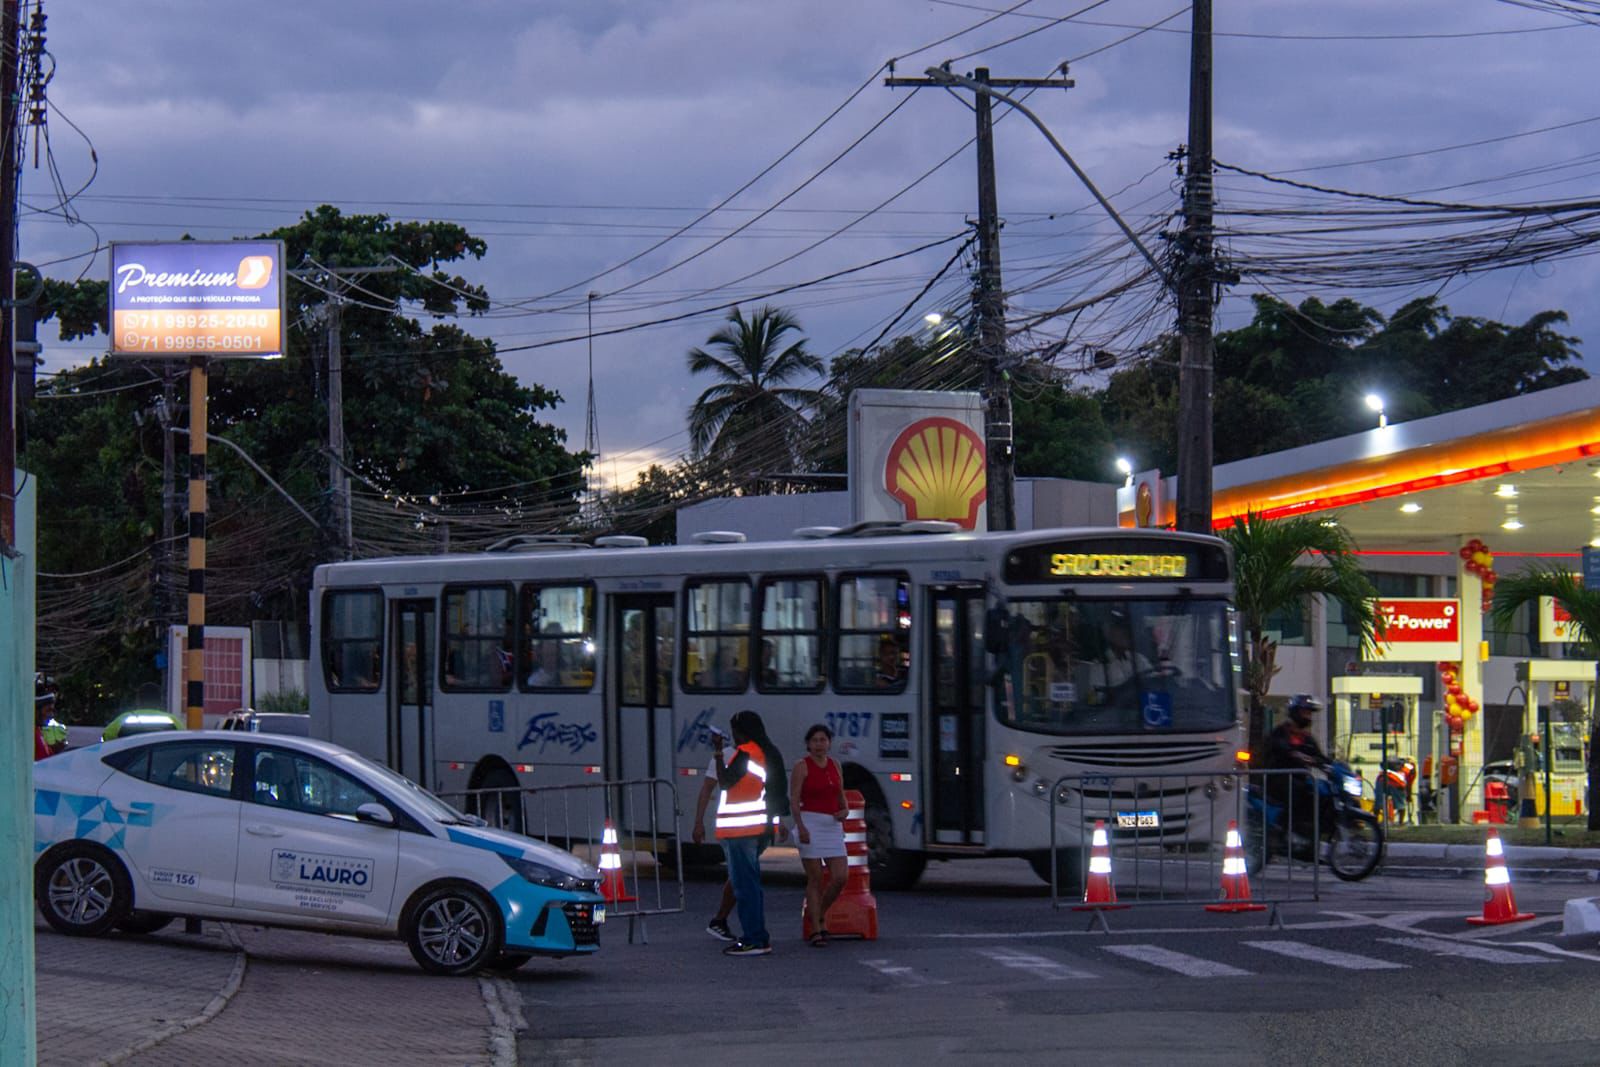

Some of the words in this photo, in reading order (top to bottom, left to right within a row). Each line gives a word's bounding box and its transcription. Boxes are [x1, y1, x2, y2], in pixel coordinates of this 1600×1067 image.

[117, 263, 236, 293] Premium
[130, 295, 136, 303] A
[137, 294, 172, 305] PROTEÇÃO
[173, 295, 187, 303] QUE
[189, 295, 202, 303] SEU
[203, 294, 231, 303] VEÍCULO
[232, 295, 260, 303] PRECISA
[140, 314, 159, 329] 71
[164, 314, 268, 329] 99925-2040
[141, 336, 159, 350] 71
[164, 336, 262, 349] 99955-0501
[1383, 614, 1451, 629] V-Power
[176, 873, 195, 885] 156
[300, 864, 368, 886] LAURO
